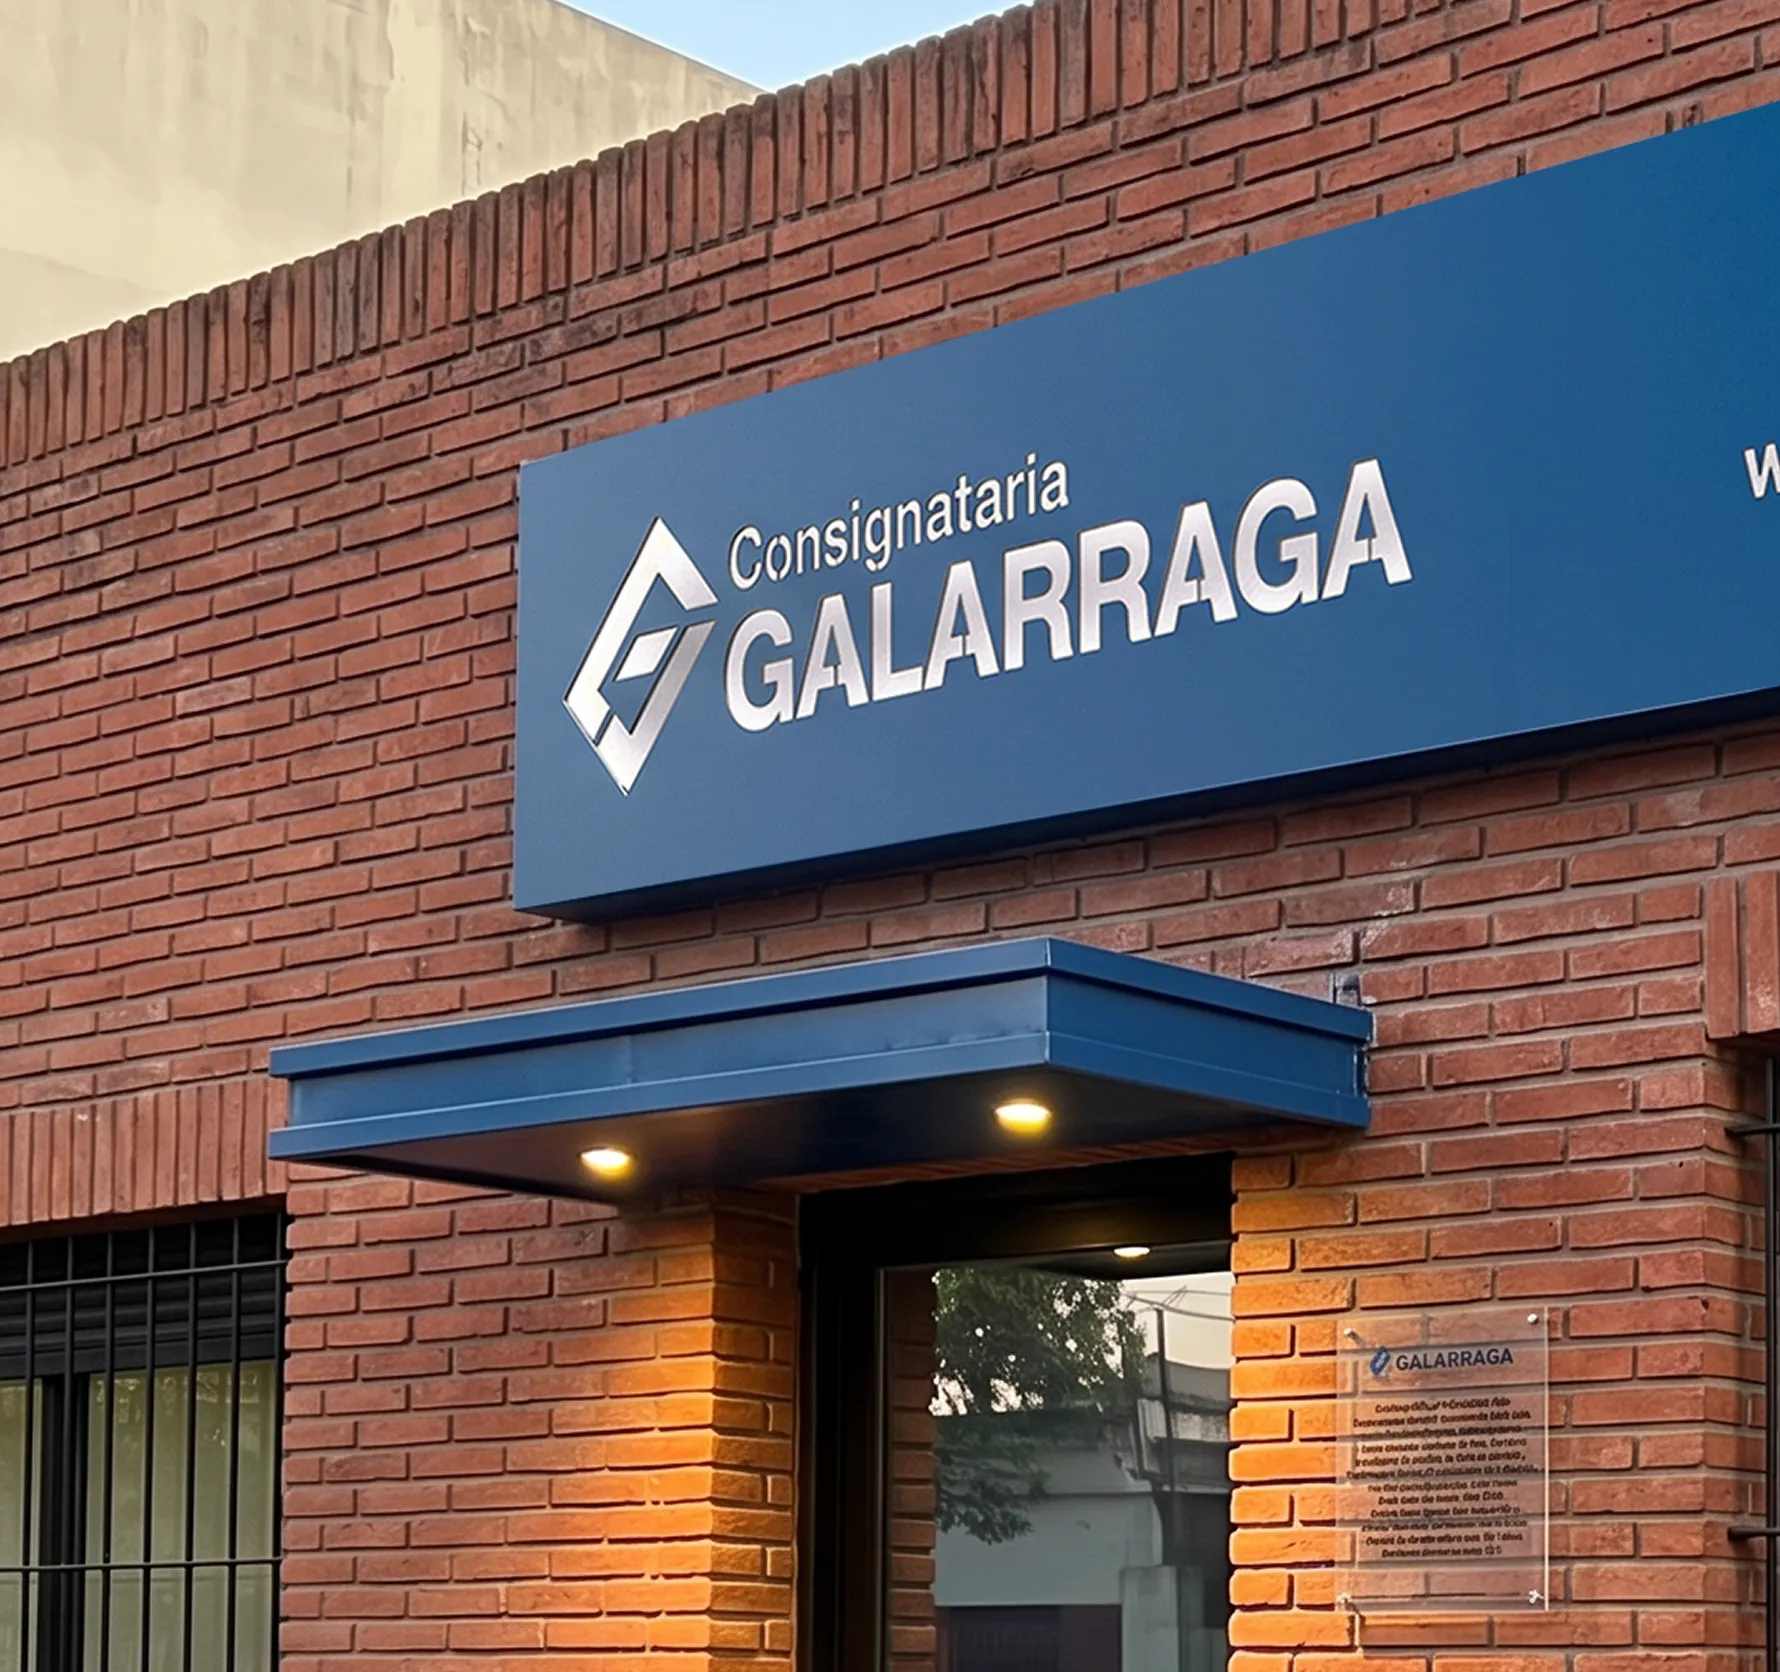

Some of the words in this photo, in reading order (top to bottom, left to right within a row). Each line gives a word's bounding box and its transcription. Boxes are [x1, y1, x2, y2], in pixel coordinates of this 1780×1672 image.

[729, 452, 1070, 591] Consignataria
[724, 457, 1413, 732] GALARRAGA
[1396, 1348, 1514, 1371] GALARRAGA
